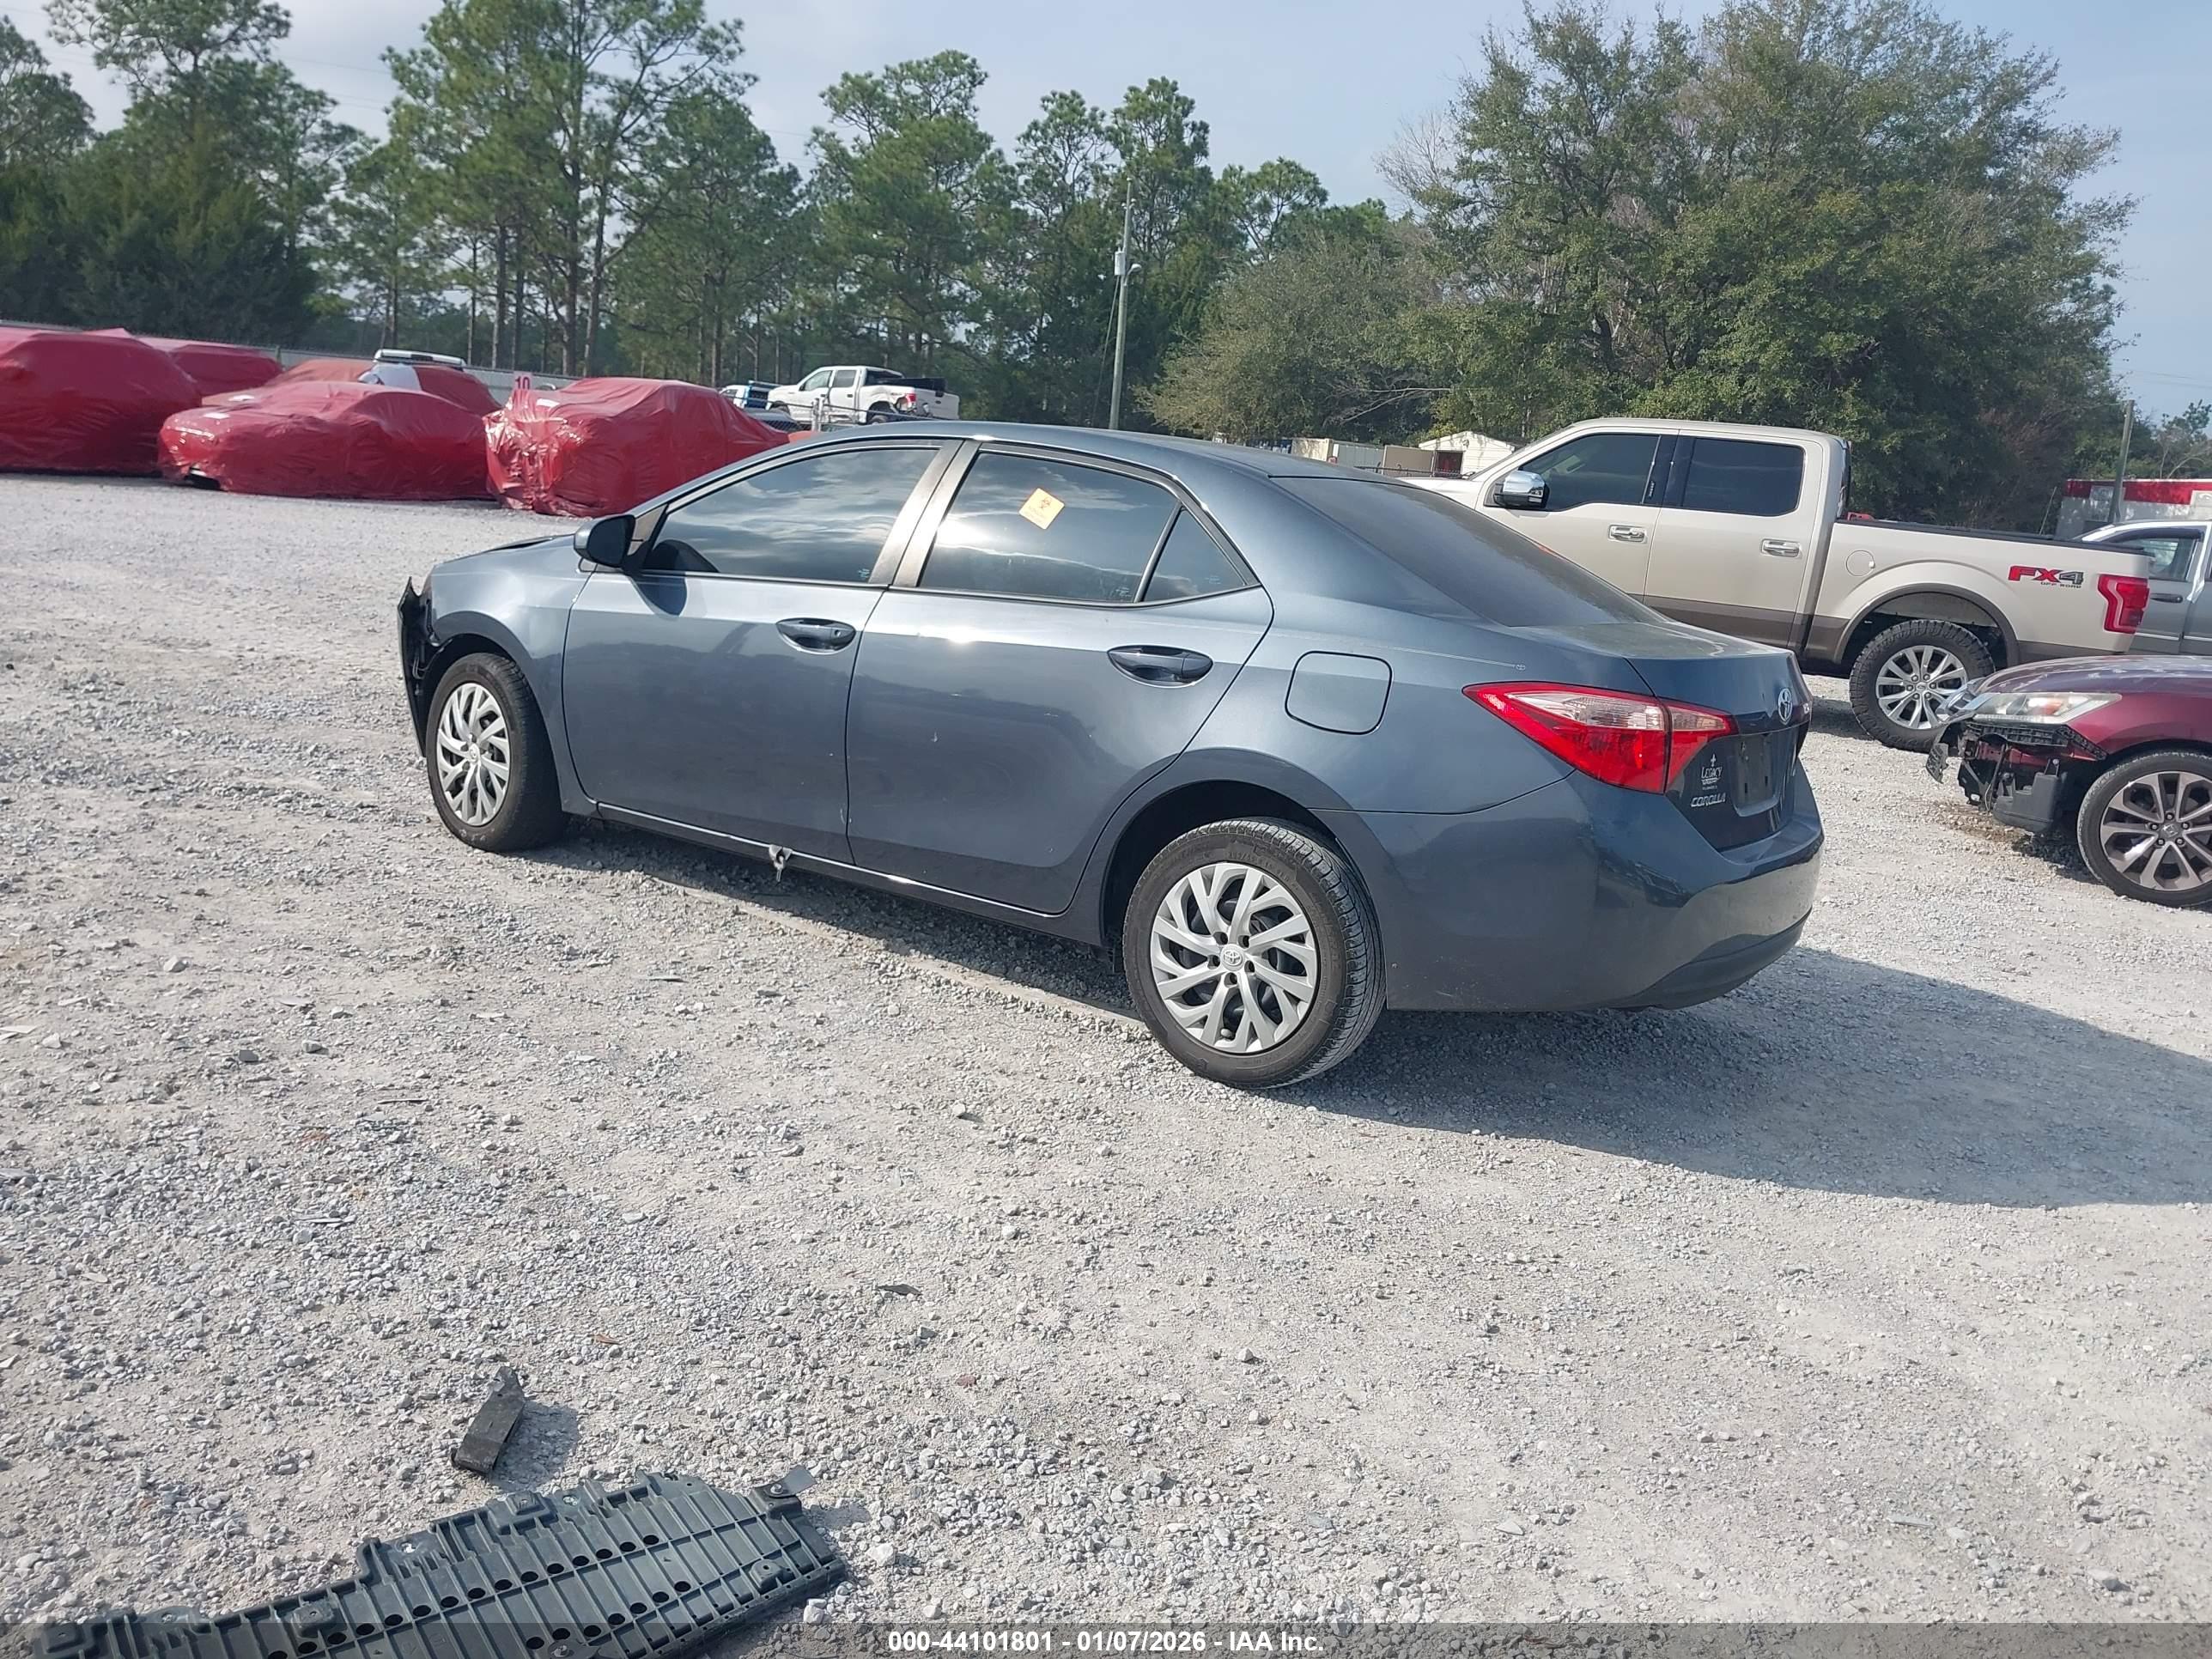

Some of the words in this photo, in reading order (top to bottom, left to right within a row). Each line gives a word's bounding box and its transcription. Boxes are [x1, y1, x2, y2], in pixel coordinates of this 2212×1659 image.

[2008, 565, 2084, 585] FX4
[1701, 766, 1723, 779] LEGACY
[1691, 792, 1726, 807] COROLLA
